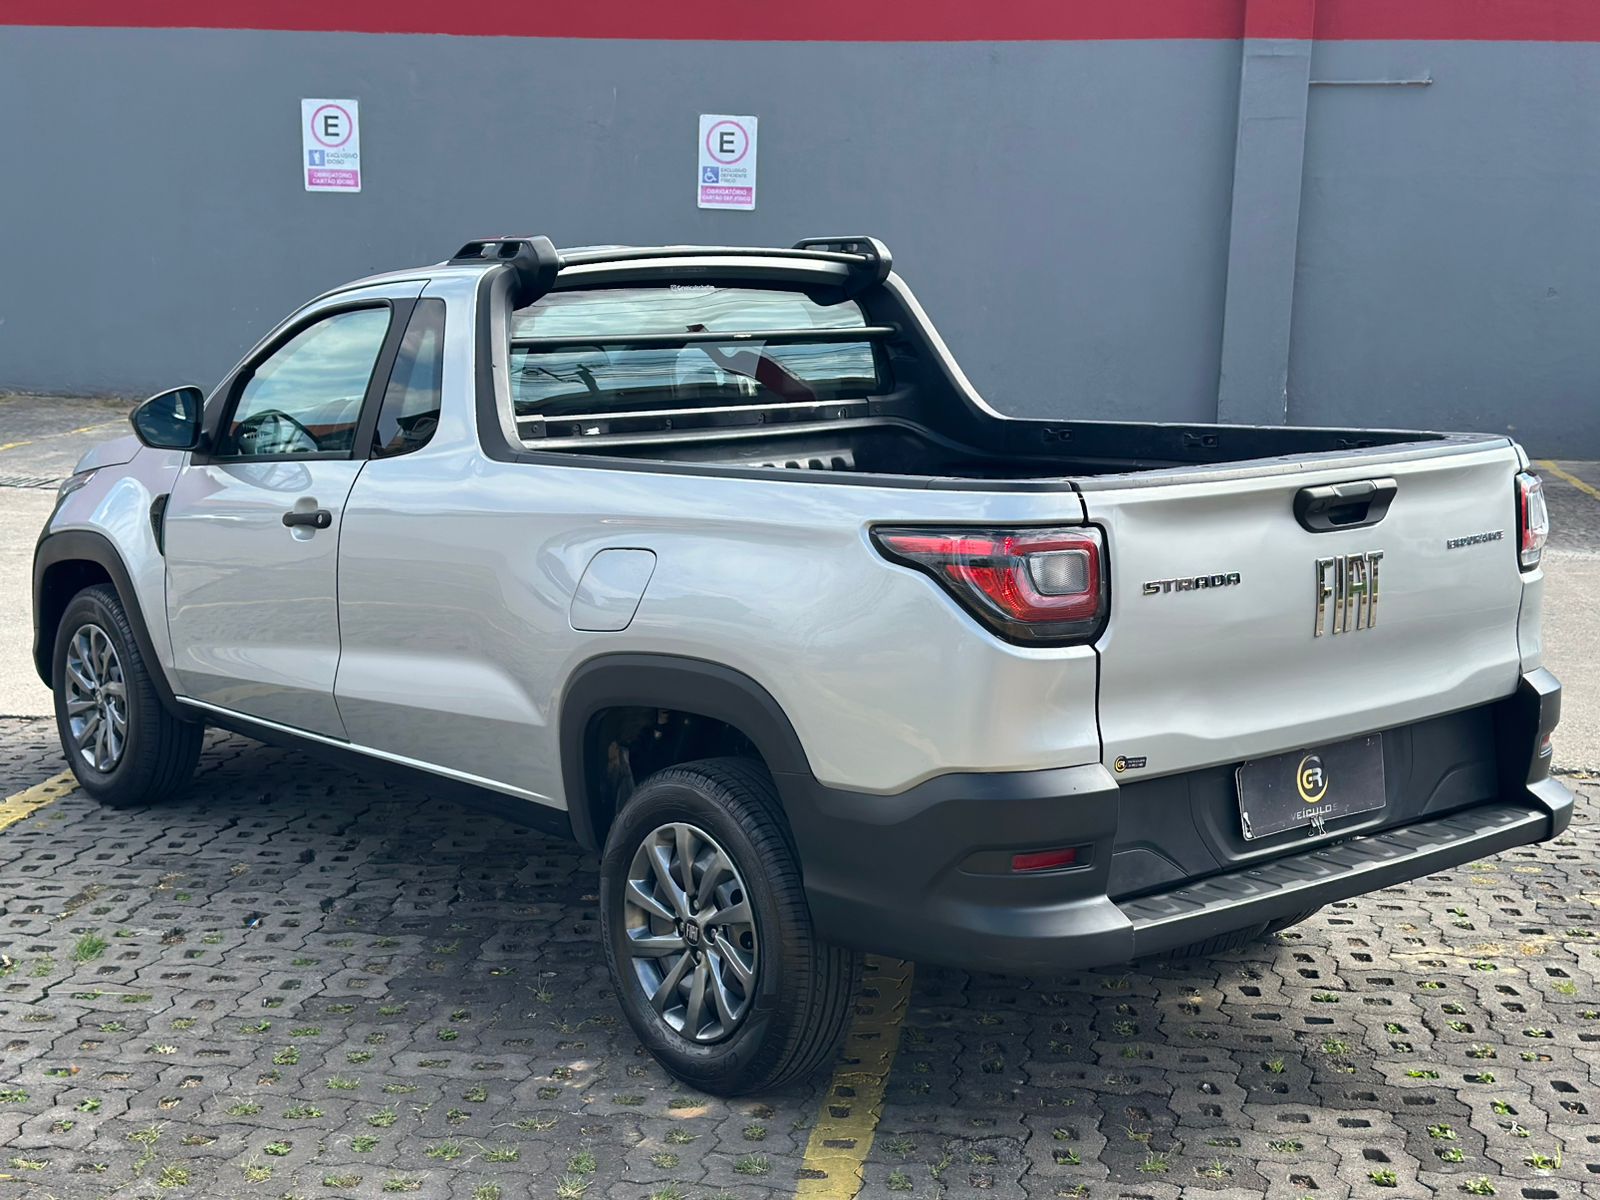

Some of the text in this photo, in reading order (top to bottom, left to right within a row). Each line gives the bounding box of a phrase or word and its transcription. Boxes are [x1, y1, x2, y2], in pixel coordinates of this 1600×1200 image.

[324, 115, 340, 137] E
[719, 131, 736, 154] E
[706, 187, 747, 195] OBRIGATÓRIO
[1143, 571, 1241, 596] STRADA
[1314, 549, 1384, 638] FIAT
[686, 922, 699, 942] FIAT
